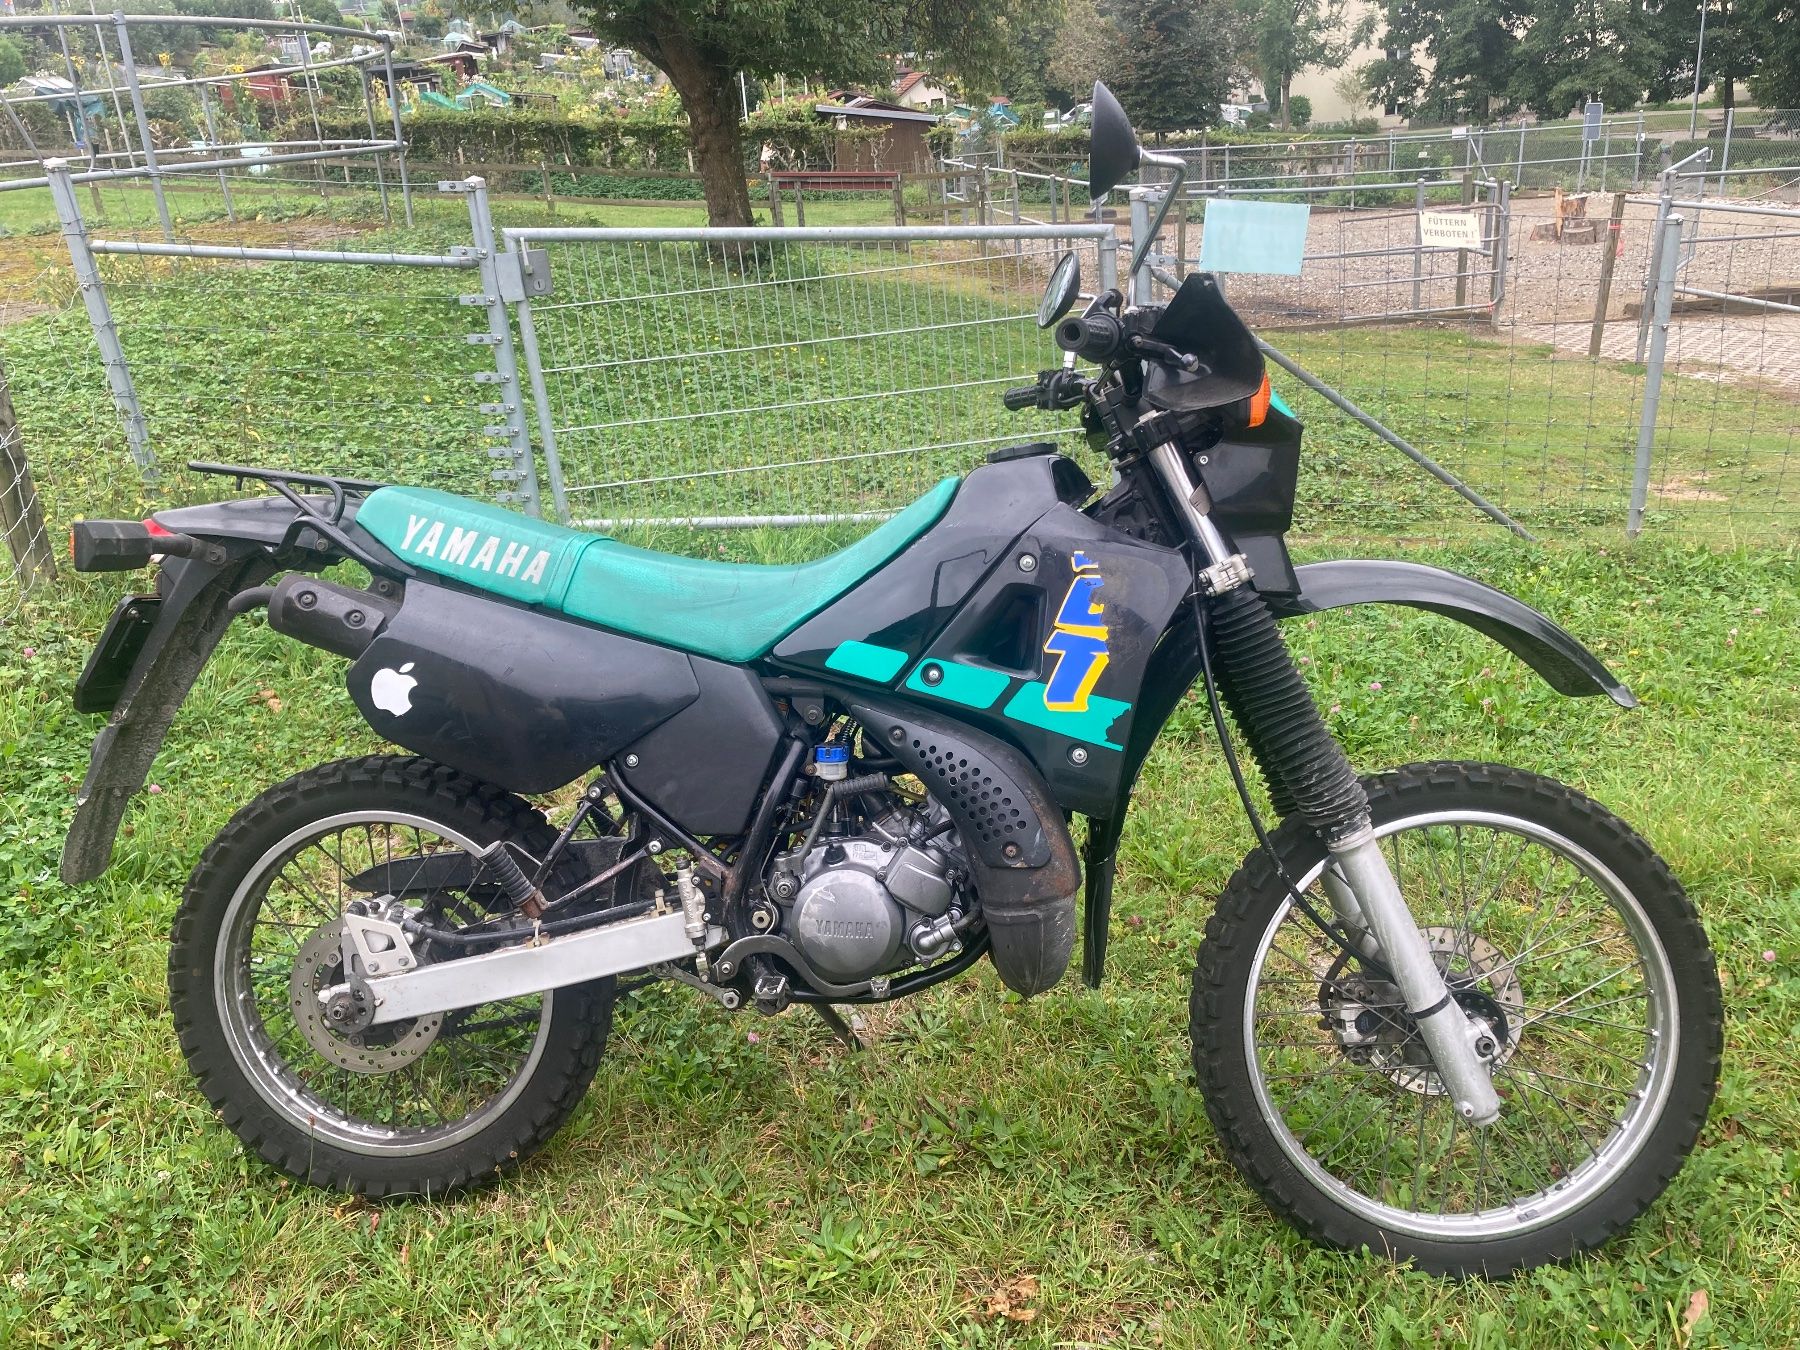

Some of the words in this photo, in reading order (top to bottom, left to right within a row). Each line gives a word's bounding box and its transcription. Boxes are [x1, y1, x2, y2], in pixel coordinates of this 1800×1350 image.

[1428, 216, 1467, 226] FÜTTERN
[1423, 228, 1468, 238] VERBOTEN
[401, 515, 551, 585] YAMAHA
[816, 919, 874, 939] YAMAHA
